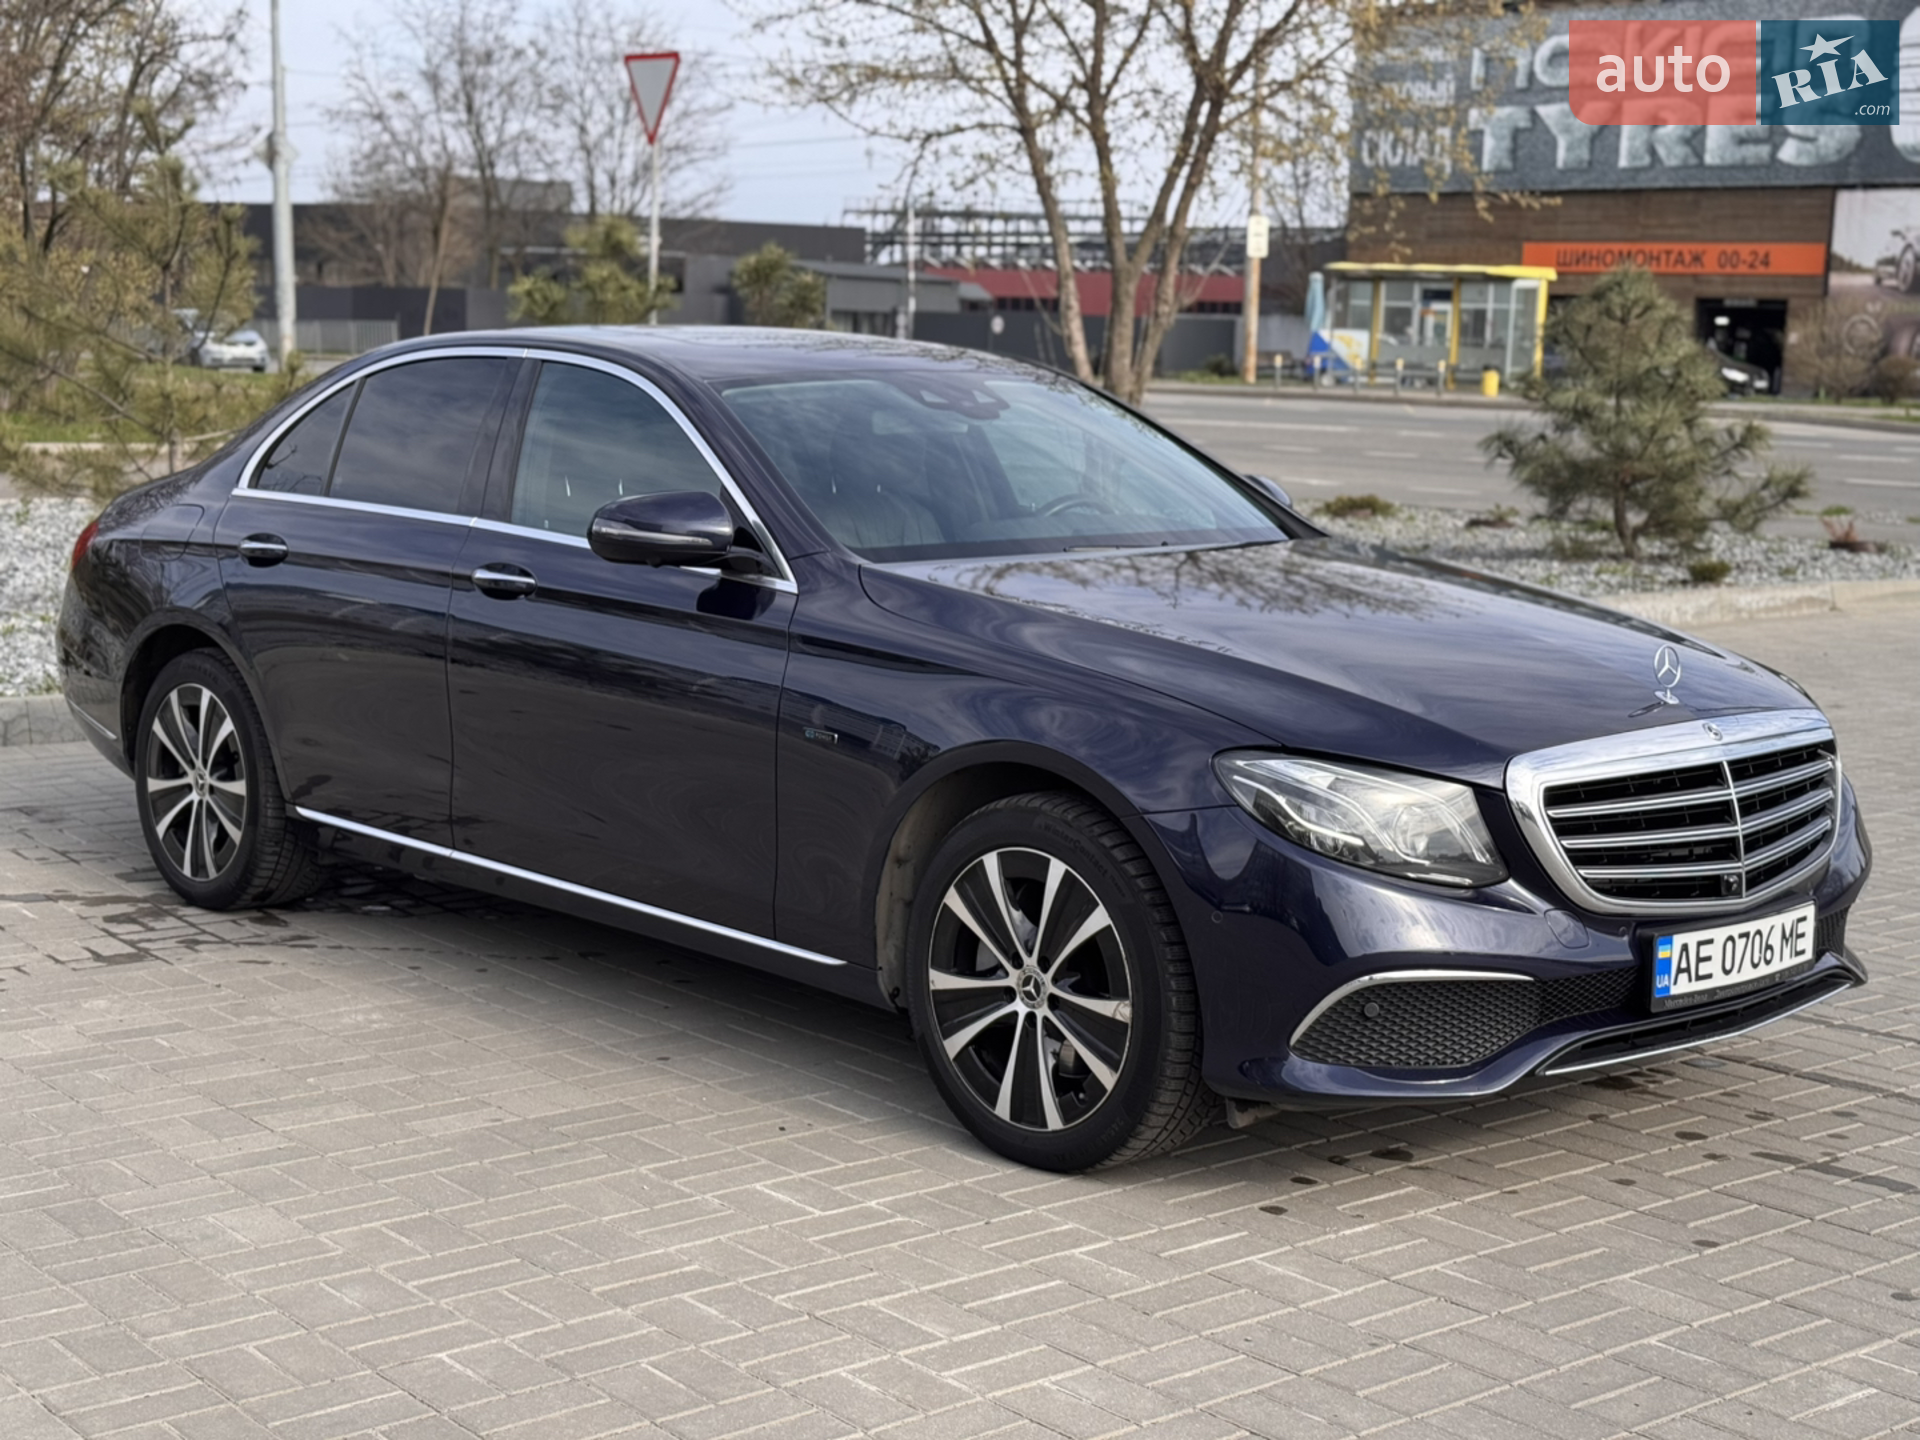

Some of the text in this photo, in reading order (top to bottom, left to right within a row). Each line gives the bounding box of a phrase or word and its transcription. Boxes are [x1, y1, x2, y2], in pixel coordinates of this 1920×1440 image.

[1361, 126, 1453, 175] СКЛАД
[1556, 248, 1771, 269] ШИНОМОНТАЖ 00-24
[1673, 915, 1808, 986] AE 0706 ME
[1656, 974, 1669, 988] UA
